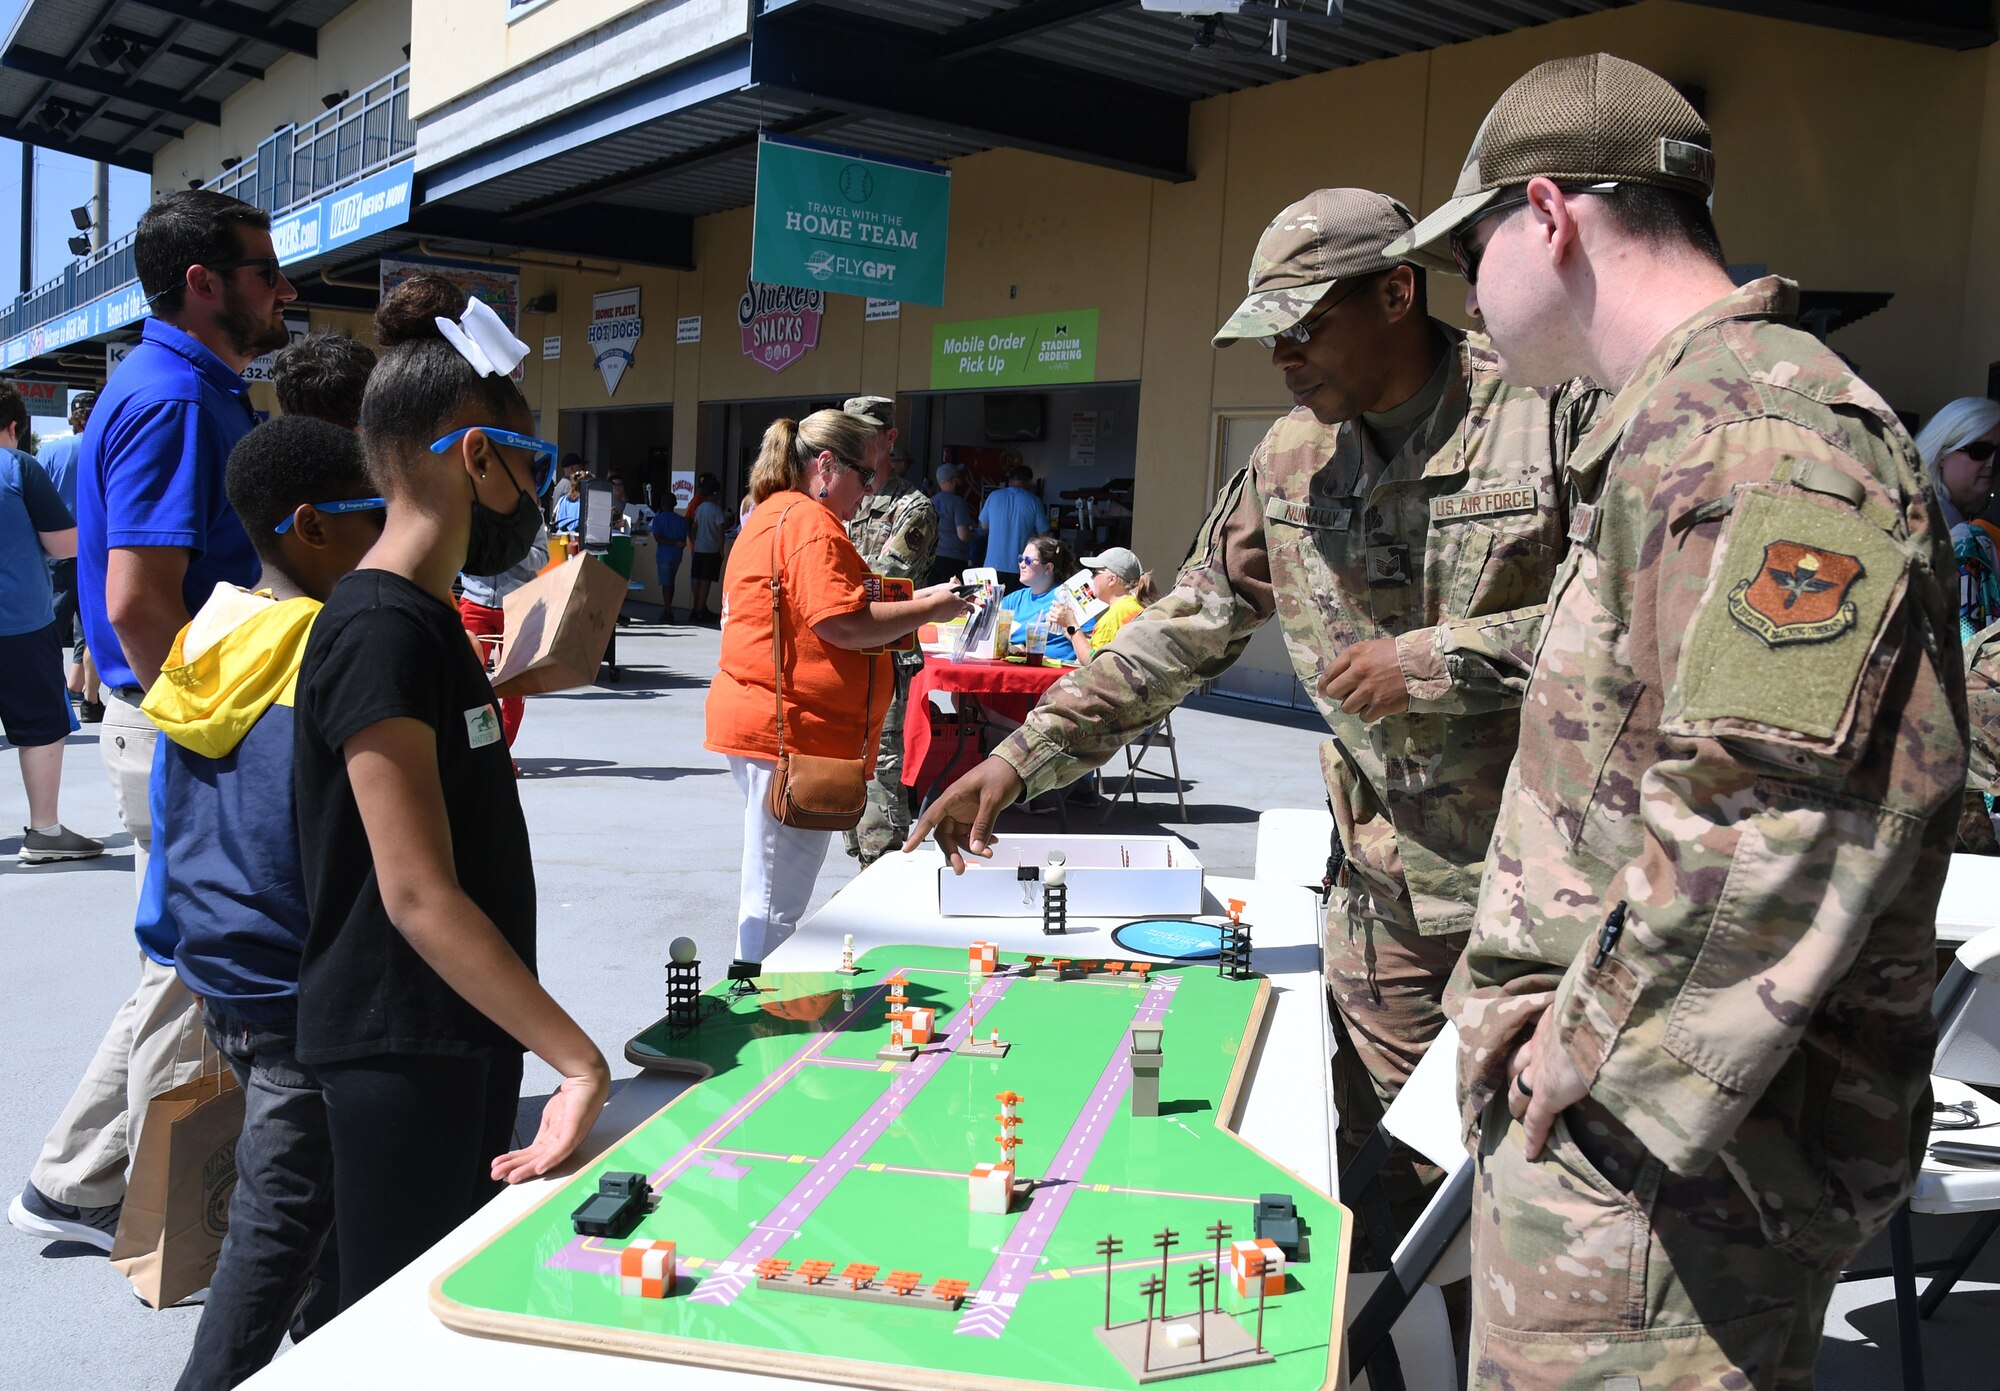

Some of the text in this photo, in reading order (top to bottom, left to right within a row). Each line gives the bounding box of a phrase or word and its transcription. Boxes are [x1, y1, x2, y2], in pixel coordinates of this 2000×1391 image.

[331, 182, 408, 238] WLOX NEWS NOW
[807, 202, 902, 225] TRAVEL WITH THE
[785, 211, 918, 249] HOME TEAM
[836, 256, 896, 280] FLYGPT
[107, 302, 122, 327] Home
[123, 294, 129, 321] of
[130, 290, 140, 318] the
[595, 304, 636, 320] HOME PLATE
[588, 321, 640, 342] HOT DOGS
[753, 317, 803, 346] SNACKS
[943, 332, 1026, 354] Mobile Order
[1041, 339, 1080, 351] STADIUM
[959, 355, 1005, 375] Pick Up
[1038, 350, 1082, 361] ORDERING
[515, 438, 543, 449] Singing River
[1435, 490, 1531, 516] U.S. AIR FORCE
